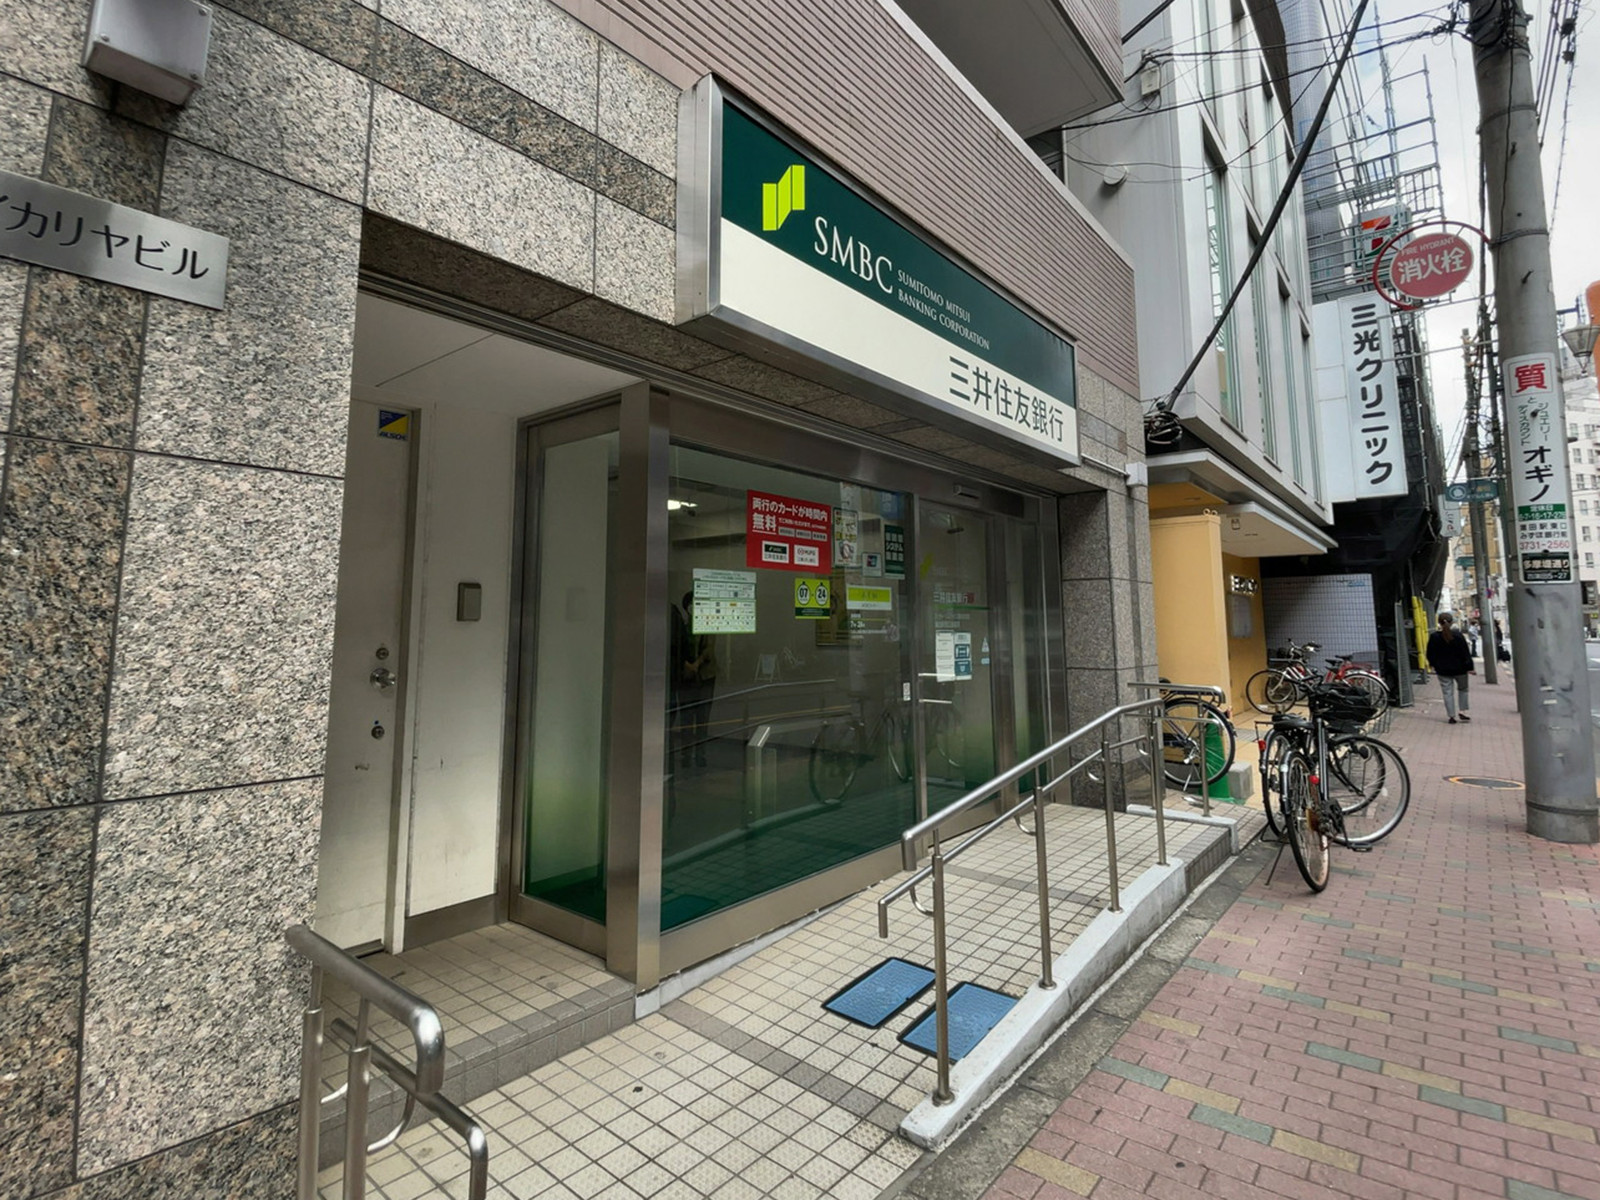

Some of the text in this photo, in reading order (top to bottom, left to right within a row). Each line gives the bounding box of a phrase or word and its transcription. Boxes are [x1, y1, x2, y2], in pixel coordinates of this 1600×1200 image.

[0, 195, 209, 280] カリヤビル
[814, 215, 893, 295] SMBC
[1401, 237, 1455, 257] FIRE HYDRANT
[1397, 246, 1467, 285] 消火栓
[897, 269, 971, 323] SUMITOMO MITSUI
[897, 289, 990, 351] BANKING CORPORATION
[949, 354, 1064, 443] 三井住友銀行
[1350, 302, 1394, 485] 三光クリニック
[1515, 363, 1547, 393] 質
[1523, 445, 1554, 503] オギノ
[752, 496, 828, 523] 両行のカードが時間内
[752, 512, 777, 532] 無料
[799, 587, 826, 599] 07 24
